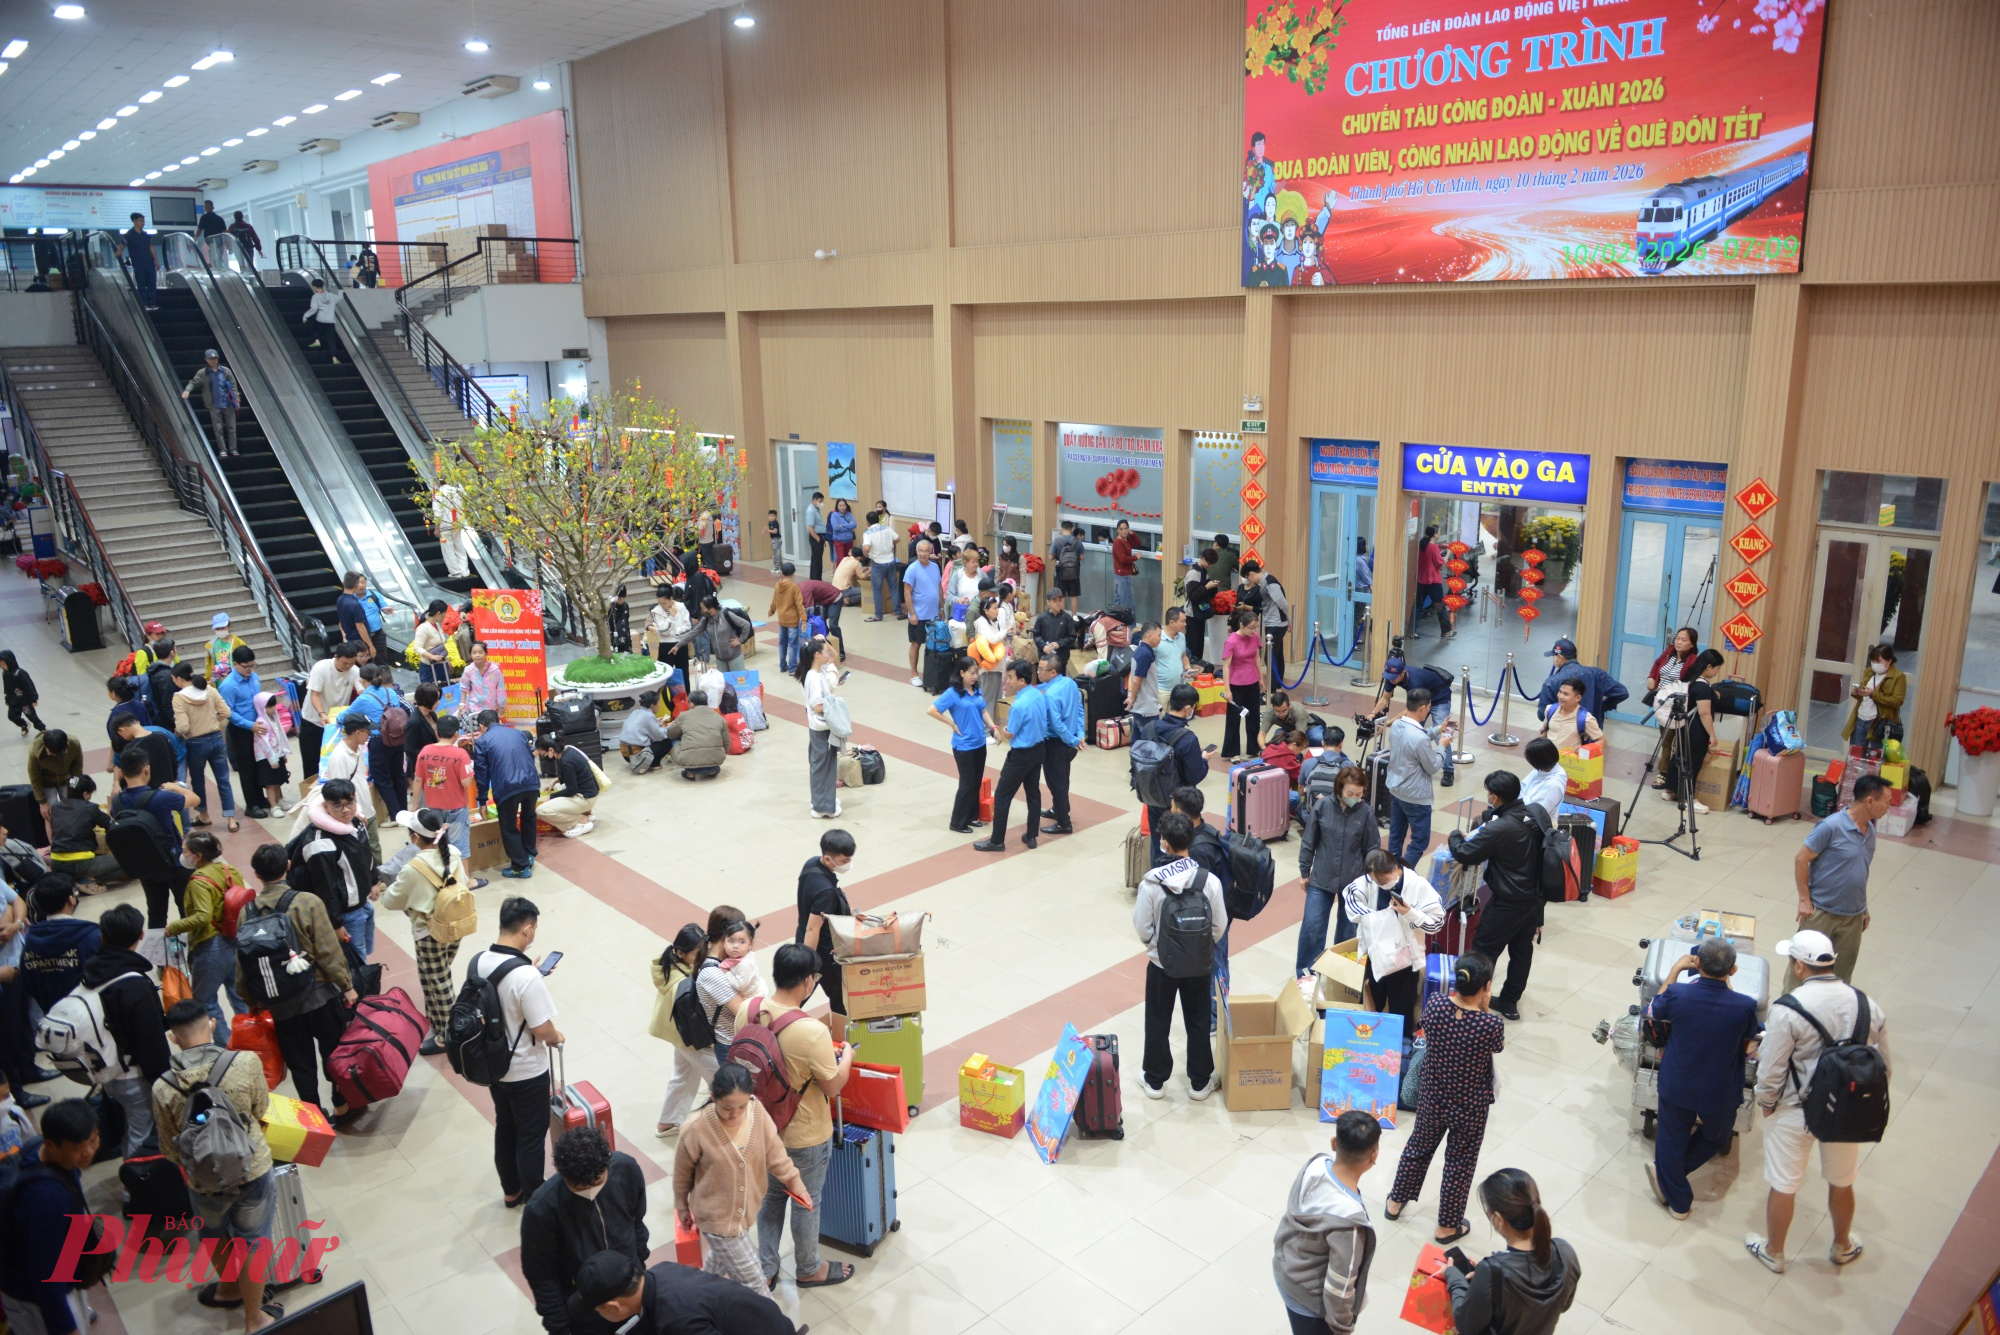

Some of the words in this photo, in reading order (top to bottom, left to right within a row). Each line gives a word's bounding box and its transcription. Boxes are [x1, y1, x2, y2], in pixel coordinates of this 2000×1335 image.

[1376, 22, 1408, 42] TỔNG
[1412, 17, 1441, 37] LIÊN
[1444, 11, 1482, 31] ĐOÀN
[1485, 10, 1510, 24] LAO
[1345, 40, 1511, 97] CHƯƠNG
[1521, 17, 1667, 73] TRÌNH
[1342, 104, 1401, 136] CHUYẾN
[1405, 103, 1439, 130] TÀU
[1442, 98, 1487, 125] CÔNG
[1491, 90, 1544, 120] ĐOÀN
[1560, 81, 1615, 112] XUÂN
[1619, 77, 1665, 106] 2026
[1307, 151, 1350, 177] ĐOÀN
[1353, 147, 1393, 174] VIÊN,
[1397, 144, 1441, 169] CÔNG
[1445, 137, 1493, 164] NHÂN
[1497, 136, 1534, 160] LAO
[1538, 128, 1591, 161] ĐỘNG
[1596, 119, 1622, 152] VỀ
[1626, 118, 1666, 148] QUÊ
[1671, 114, 1717, 145] ĐÓN
[1723, 105, 1764, 138] TẾT
[1349, 182, 1382, 201] Thành
[1384, 180, 1405, 203] phố
[1407, 180, 1425, 197] Hồ
[1426, 178, 1447, 196] Chí
[1449, 175, 1481, 196] Minh,
[1485, 173, 1512, 194] ngày
[1516, 173, 1530, 188] 10
[1532, 168, 1567, 189] tháng
[1571, 167, 1578, 183] 2
[1581, 168, 1609, 184] năm
[1612, 162, 1645, 182] 2026
[1562, 239, 1707, 265] 10/02/2026
[1723, 235, 1799, 260] 07:09
[1247, 452, 1261, 465] CHÚC
[1416, 446, 1467, 476] CỬA
[1475, 451, 1529, 480] VÀO
[1536, 460, 1576, 483] GA
[1461, 480, 1523, 497] ENTRY
[1748, 492, 1766, 506] AN
[1245, 522, 1260, 534] NĂM
[1738, 537, 1764, 551] KHANG
[1734, 581, 1759, 597] THỊNH
[1730, 623, 1754, 640] VƯỢNG
